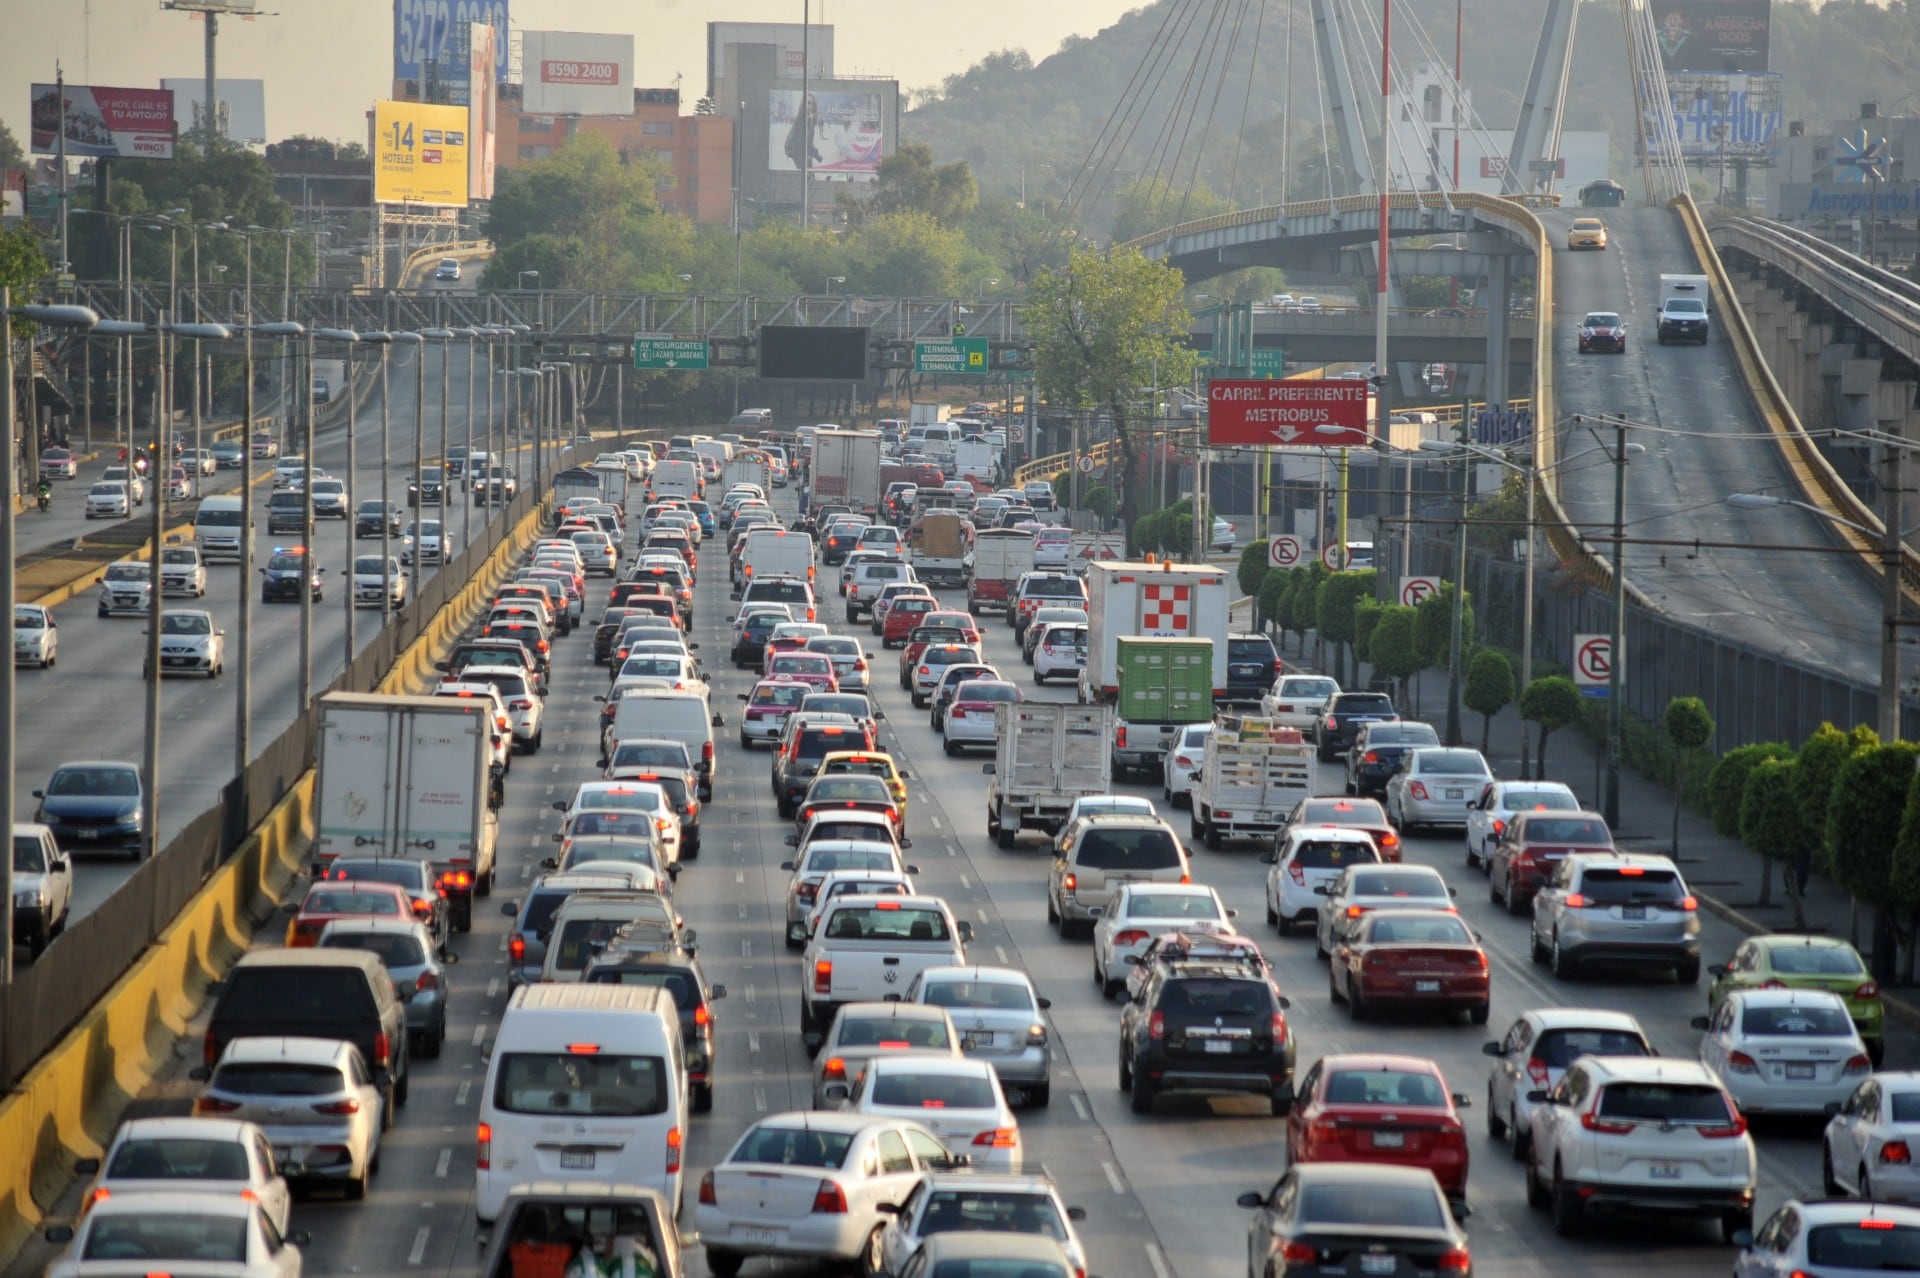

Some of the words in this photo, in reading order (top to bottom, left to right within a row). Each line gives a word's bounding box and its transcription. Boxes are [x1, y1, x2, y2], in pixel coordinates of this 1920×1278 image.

[1704, 19, 1766, 31] AMERICAN
[1719, 31, 1752, 42] GODS
[548, 63, 578, 77] 8590
[582, 64, 611, 78] 2400
[112, 110, 123, 118] TU
[127, 111, 167, 120] ANTOJO?
[392, 121, 414, 151] 14
[133, 143, 165, 152] WINGS
[383, 153, 414, 164] HOTELES
[1810, 187, 1909, 212] Aeropuerto
[652, 342, 704, 350] INSURGENTES
[652, 351, 674, 359] LAZARO
[676, 351, 704, 359] CARDENAS
[920, 363, 957, 371] TERMINAL
[960, 363, 966, 371] 2
[1212, 387, 1266, 401] CARRIL
[1268, 387, 1364, 401] PREFERENTE
[1245, 408, 1329, 422] METROBUS
